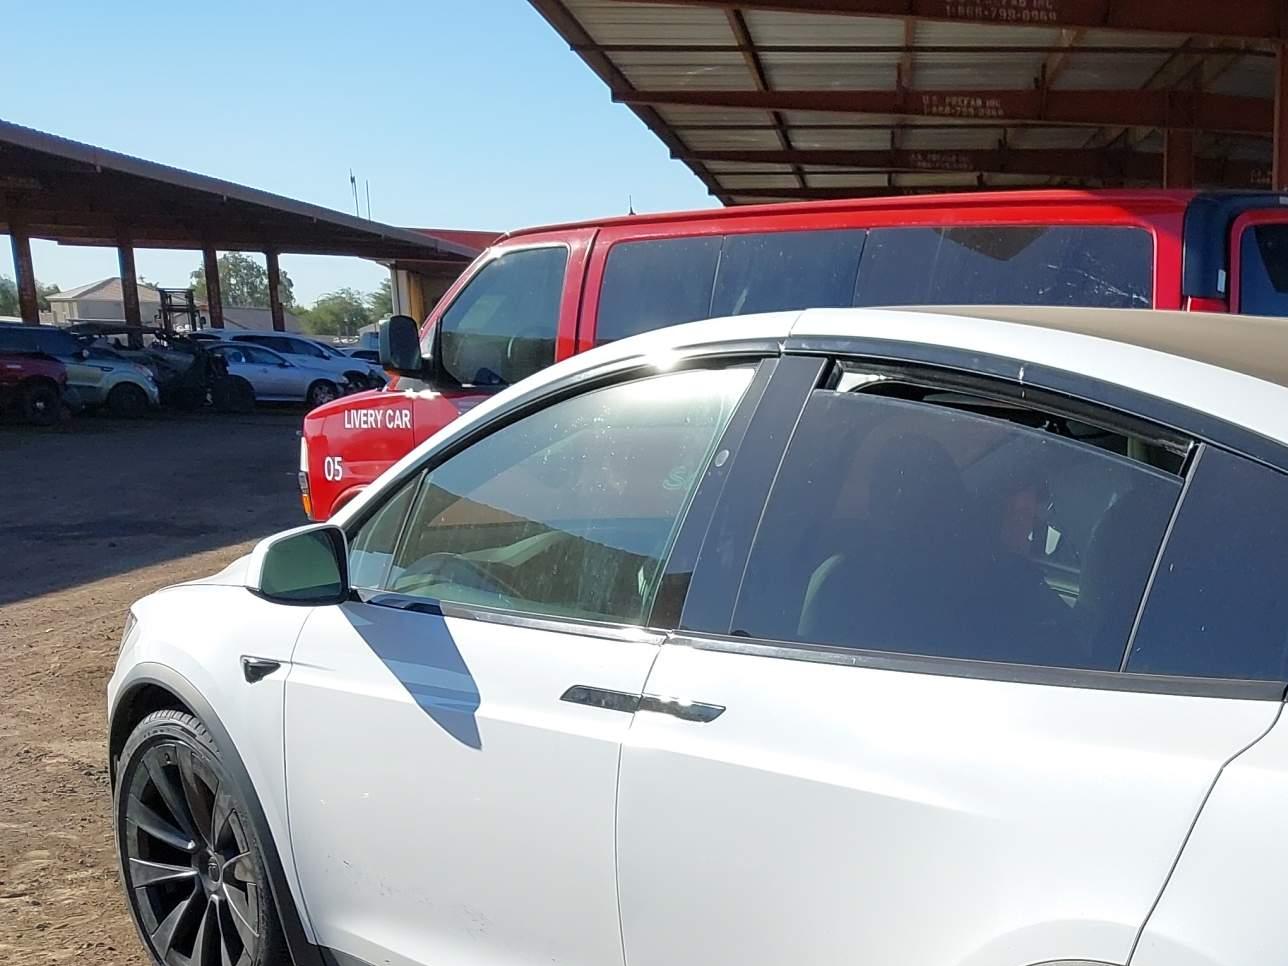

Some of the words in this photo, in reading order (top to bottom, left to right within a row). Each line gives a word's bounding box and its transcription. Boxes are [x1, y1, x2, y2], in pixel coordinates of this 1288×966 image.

[344, 409, 383, 429] LIVERY
[385, 409, 411, 429] CAR
[324, 456, 343, 481] 05
